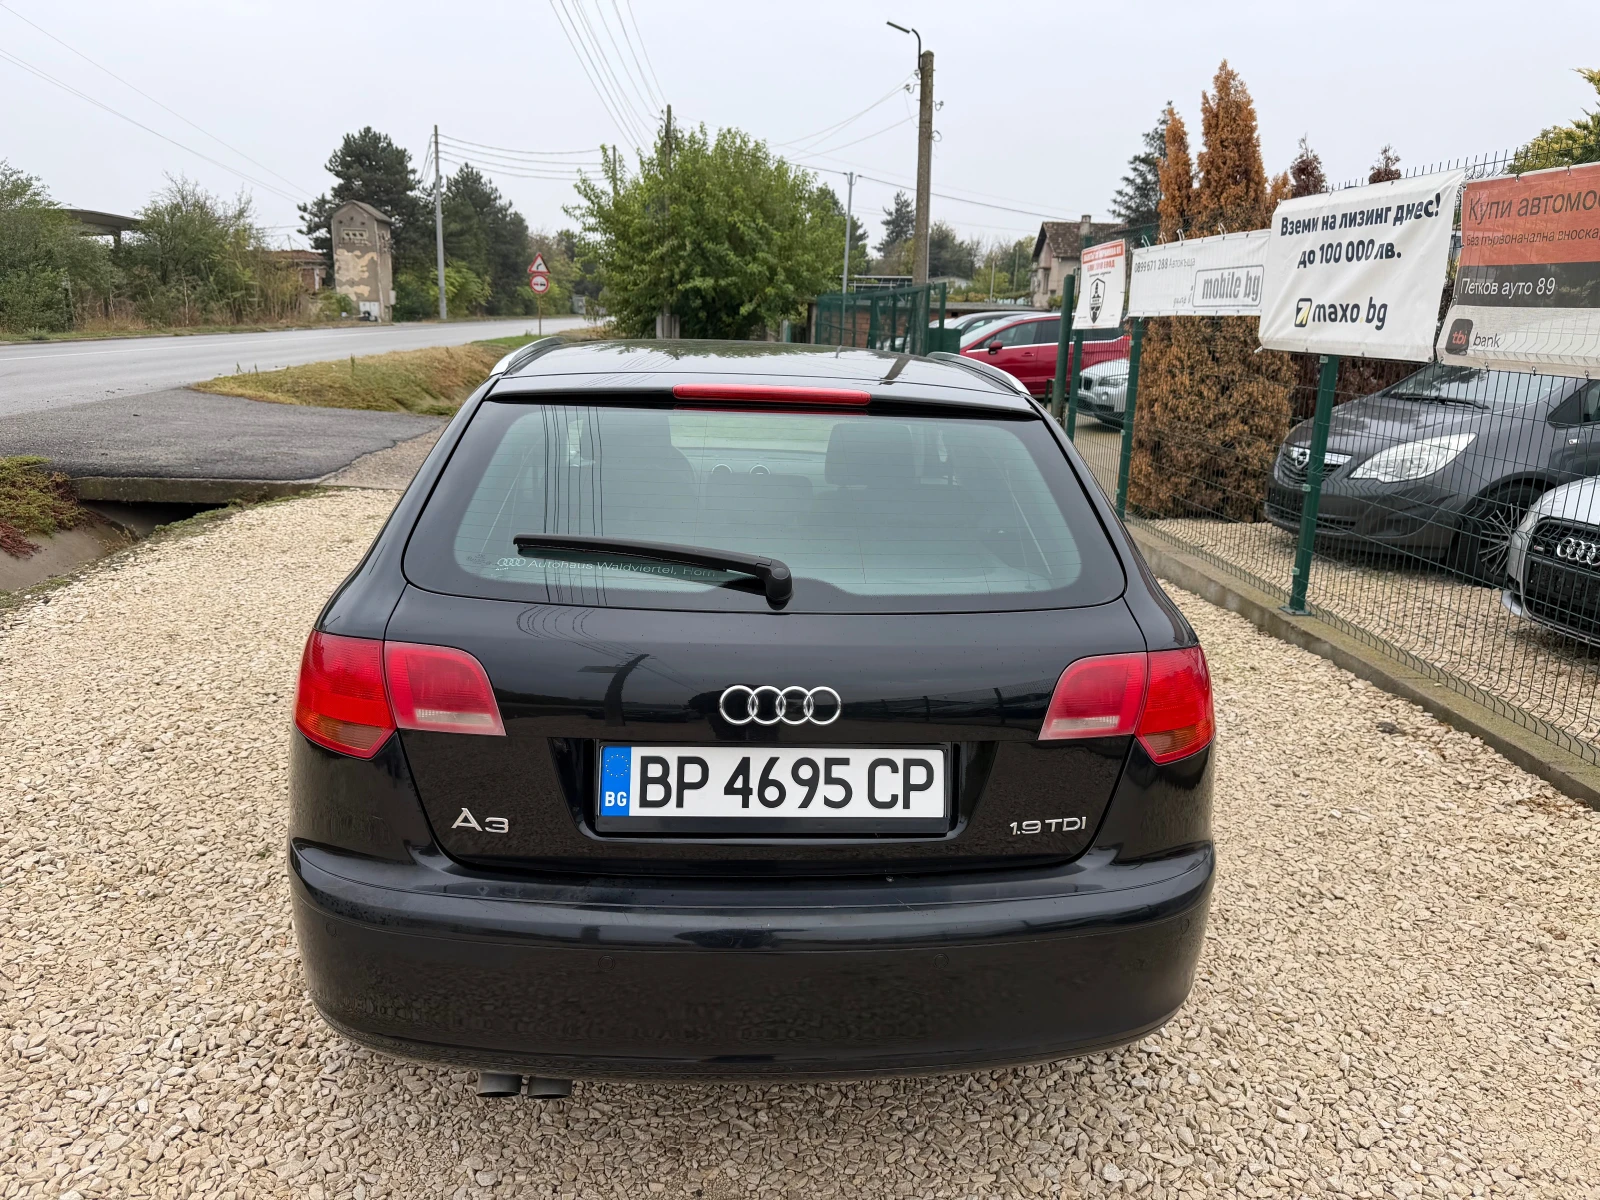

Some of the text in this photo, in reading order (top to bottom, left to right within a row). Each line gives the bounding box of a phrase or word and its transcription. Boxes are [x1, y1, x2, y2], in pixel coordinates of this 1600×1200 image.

[1280, 192, 1441, 237] Вземи на лизинг днес!
[1469, 197, 1513, 226] Купи
[1481, 230, 1556, 248] първоначална
[1157, 257, 1169, 271] 288
[1297, 238, 1402, 269] до 100 000 лв.
[1201, 270, 1261, 302] mobile bg
[1460, 277, 1556, 299] Петков ауто 89
[1452, 330, 1501, 348] tbi bank
[527, 559, 716, 577] Autohaus Waldviertel, Horn
[638, 755, 935, 810] BP 4695 CP
[604, 791, 627, 807] BG
[451, 807, 509, 834] A3
[1009, 816, 1087, 835] 1.9 TDI
